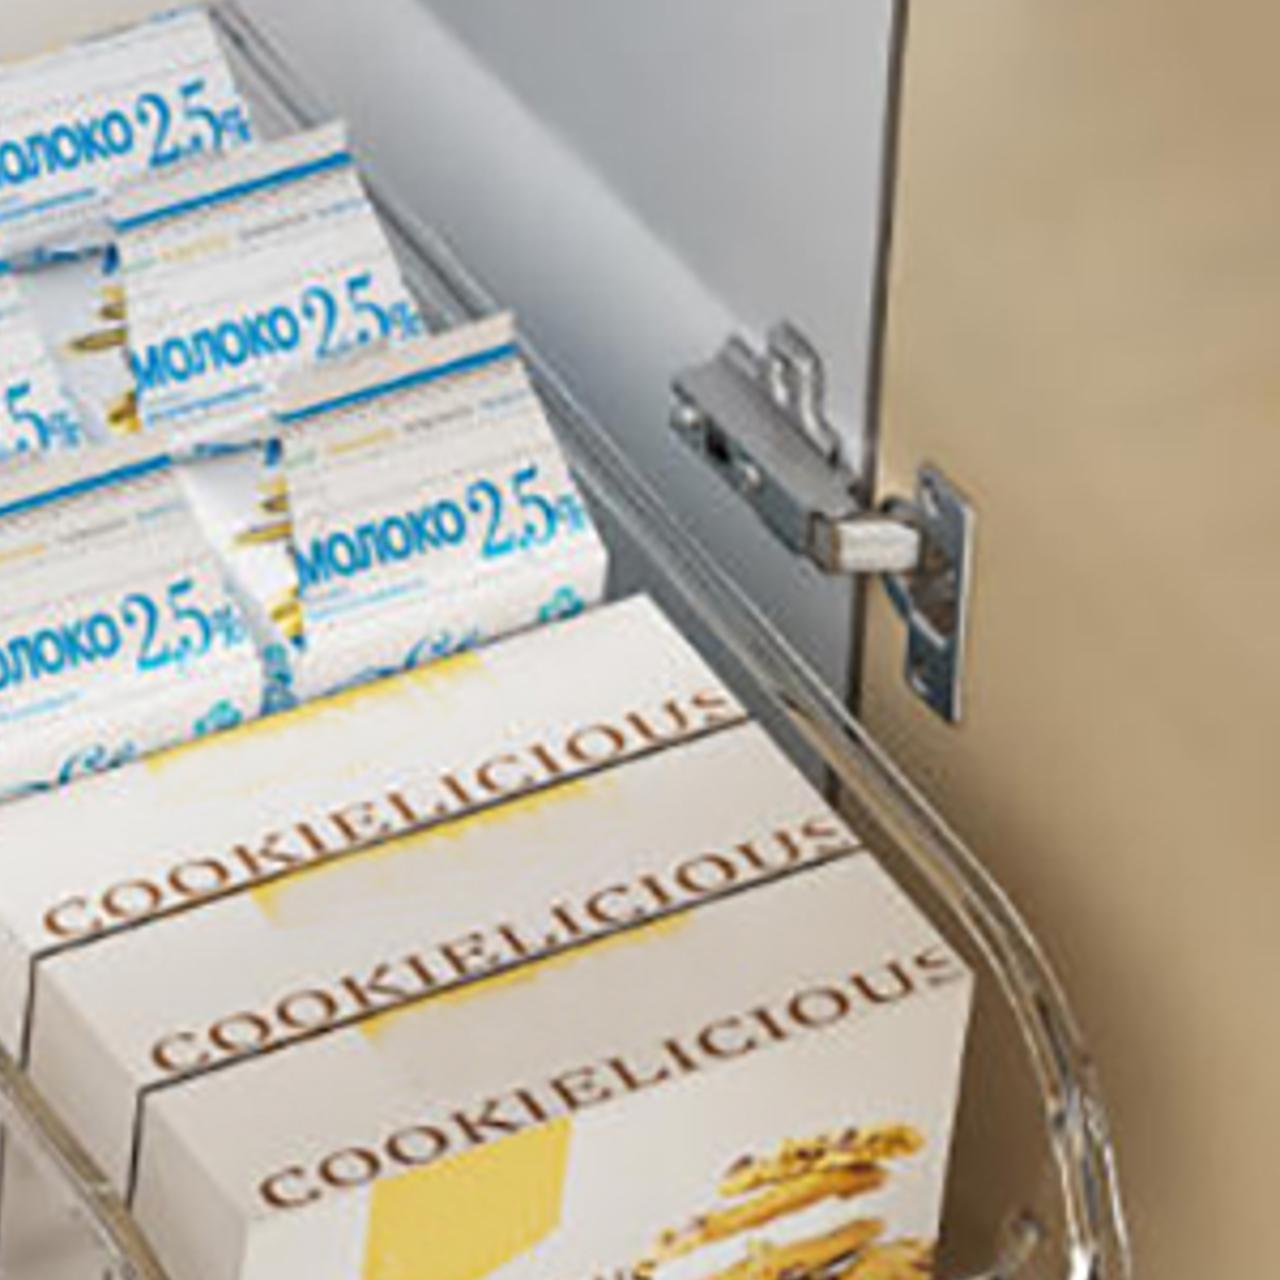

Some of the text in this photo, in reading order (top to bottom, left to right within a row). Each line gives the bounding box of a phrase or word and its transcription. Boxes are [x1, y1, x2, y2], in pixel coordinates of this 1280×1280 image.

[41, 688, 731, 940] COOKIELICIOUS
[150, 816, 846, 1076] COOKIELICIOUS
[257, 944, 966, 1208] COOKIELICIOUS
